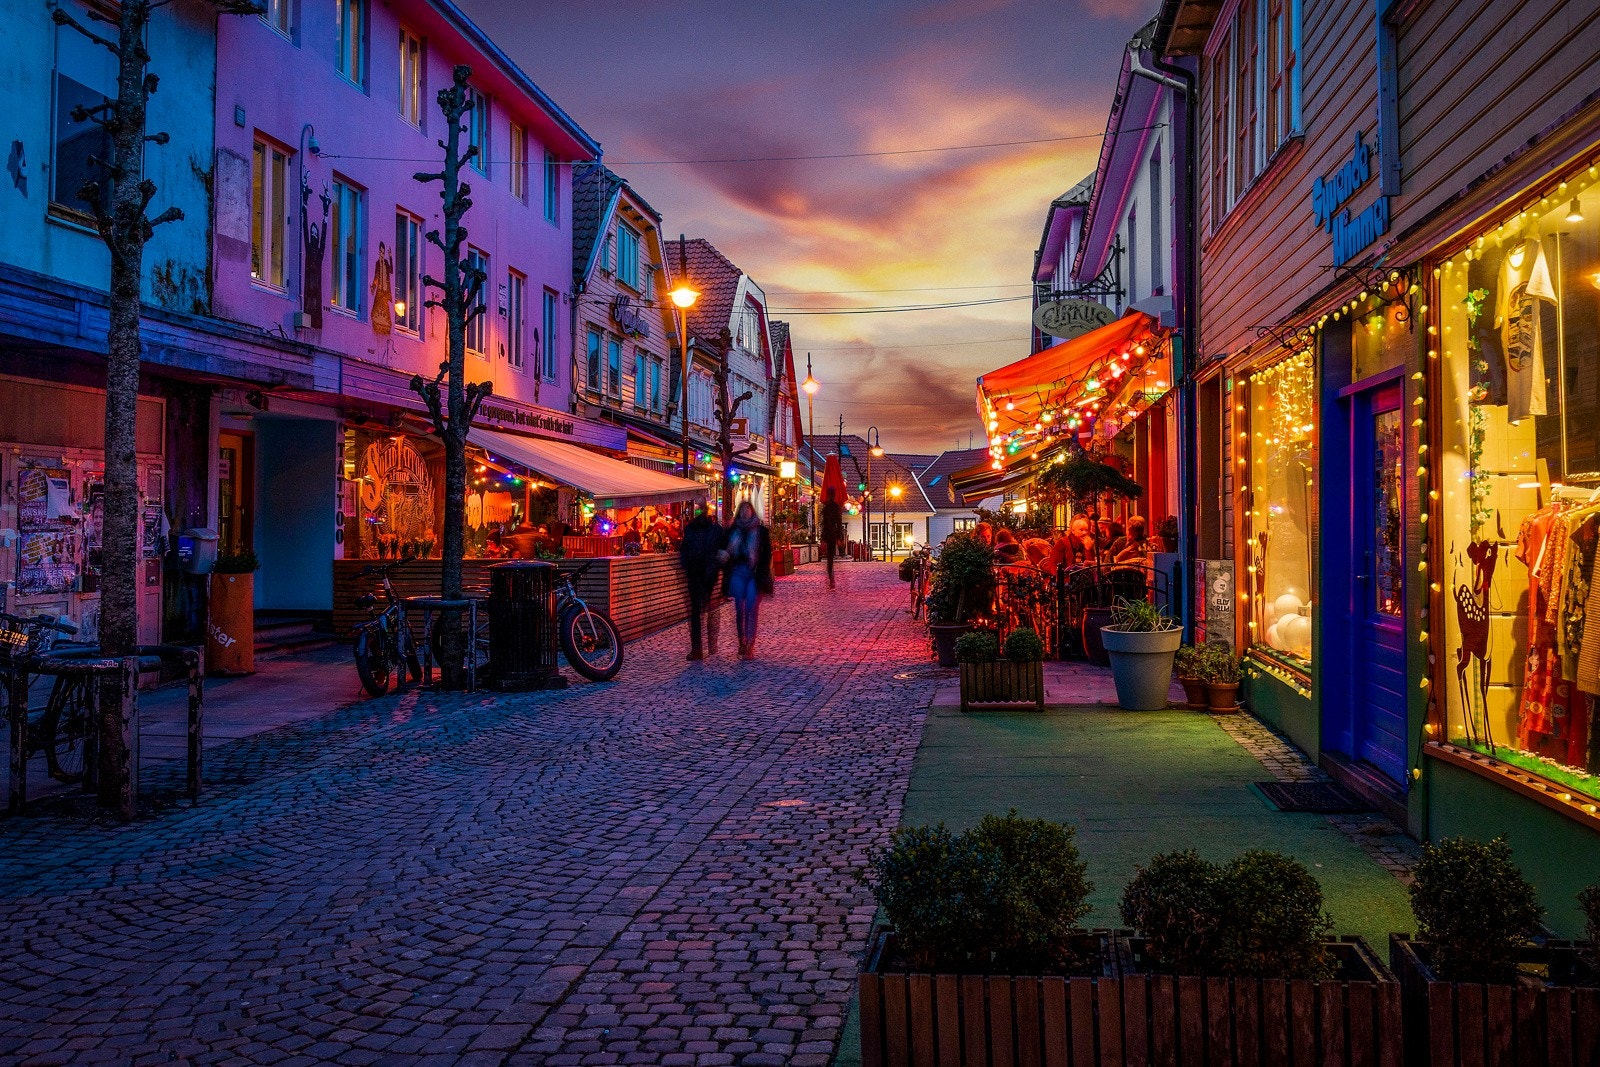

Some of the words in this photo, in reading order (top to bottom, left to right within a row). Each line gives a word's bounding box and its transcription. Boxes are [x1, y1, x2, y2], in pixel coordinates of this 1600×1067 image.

[1312, 131, 1370, 234] Syvende
[1332, 196, 1390, 269] Himmel
[336, 443, 345, 544] TATTOO
